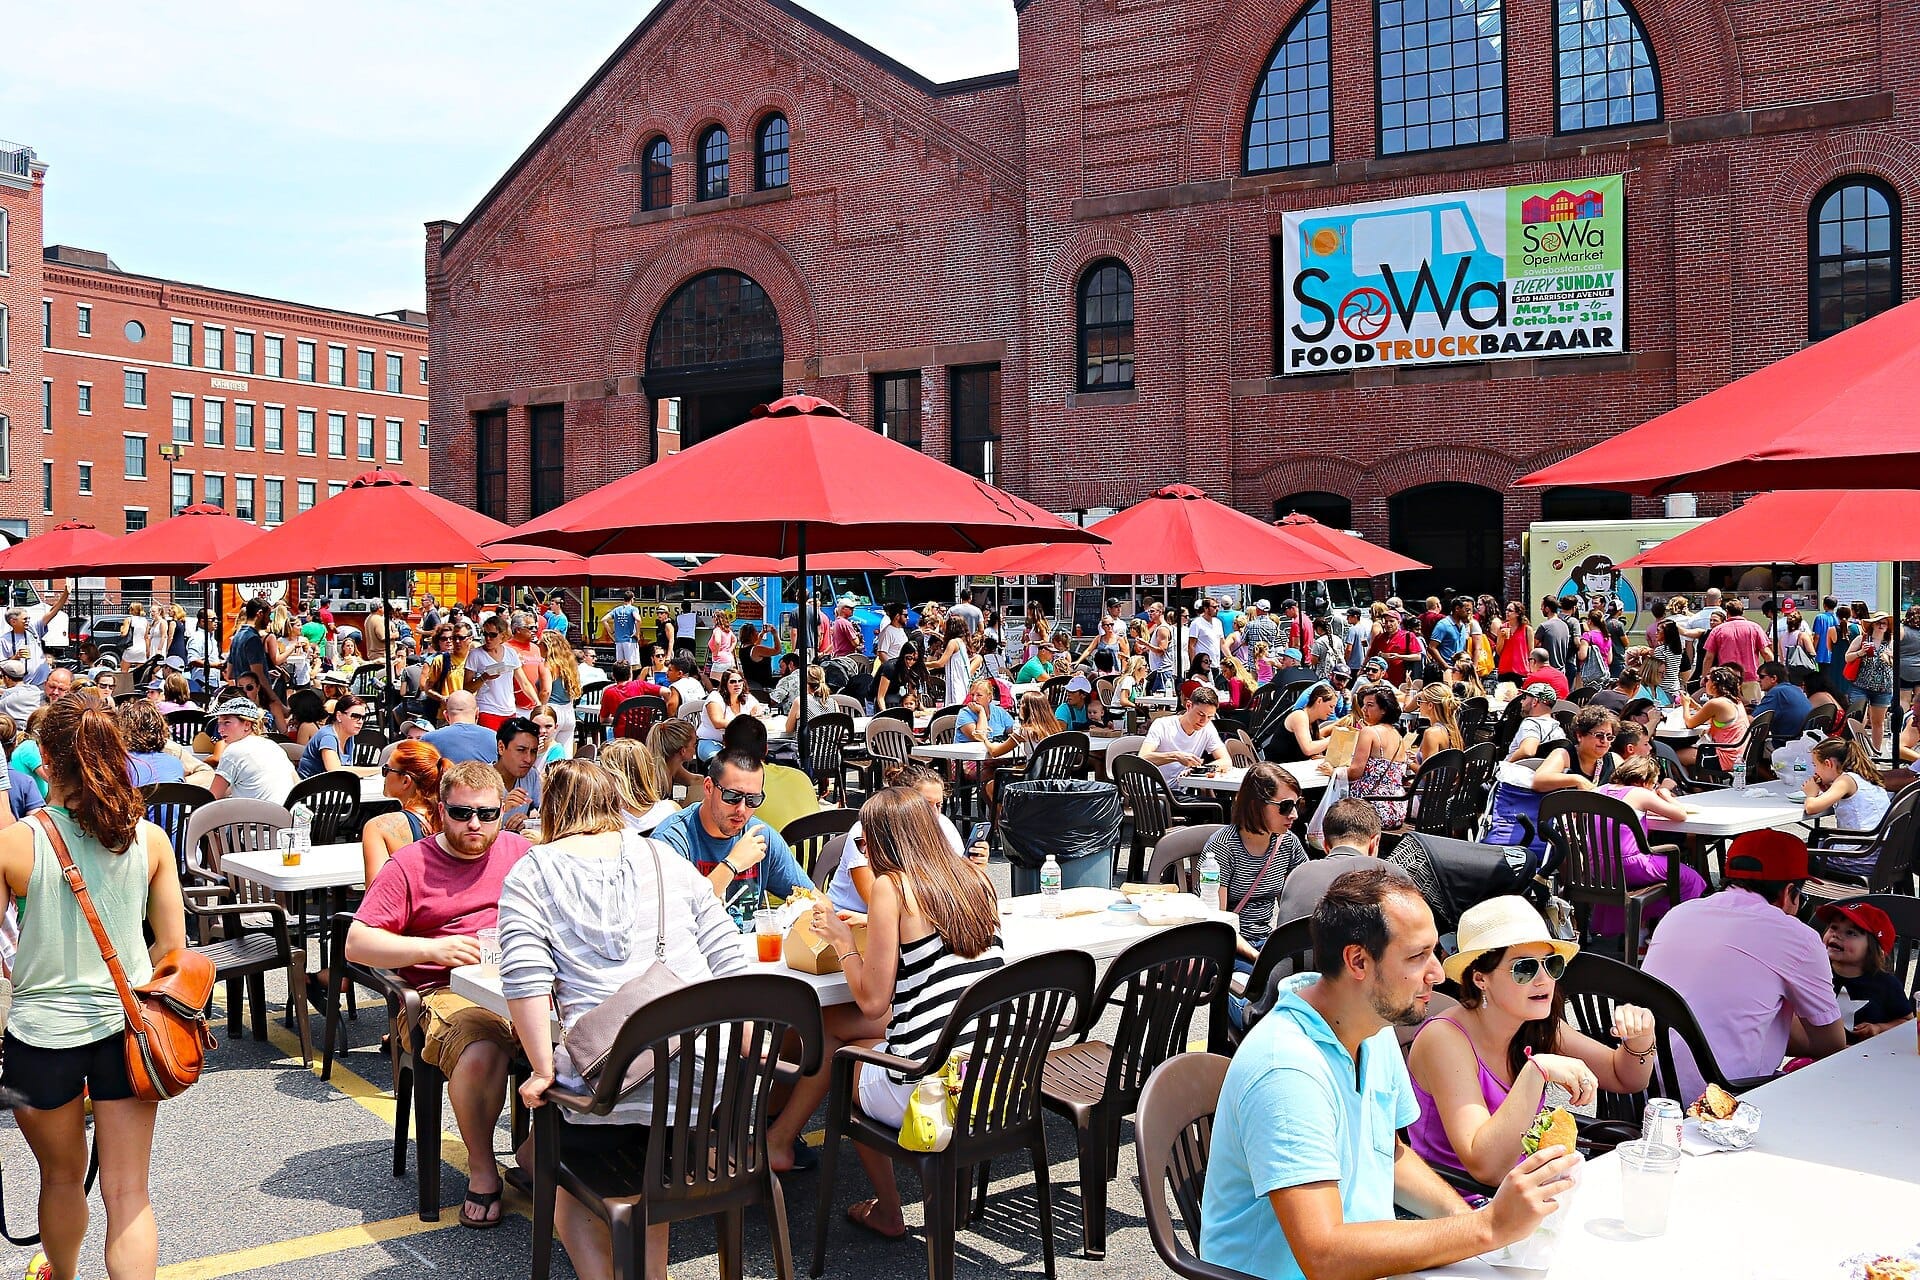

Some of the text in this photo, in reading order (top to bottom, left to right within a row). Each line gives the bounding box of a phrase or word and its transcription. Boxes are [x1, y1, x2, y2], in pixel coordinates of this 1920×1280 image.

[1522, 220, 1604, 253] SoWa
[1523, 263, 1604, 276] sowaboston.com
[1513, 272, 1615, 295] EVERY SUNDAY
[1291, 256, 1506, 343] SoWa
[1532, 291, 1575, 302] HARRISON
[1576, 289, 1610, 299] AVENUE
[1516, 304, 1551, 315] May
[1558, 301, 1579, 311] 1st
[1512, 311, 1613, 326] October 31st
[362, 576, 374, 586] 50
